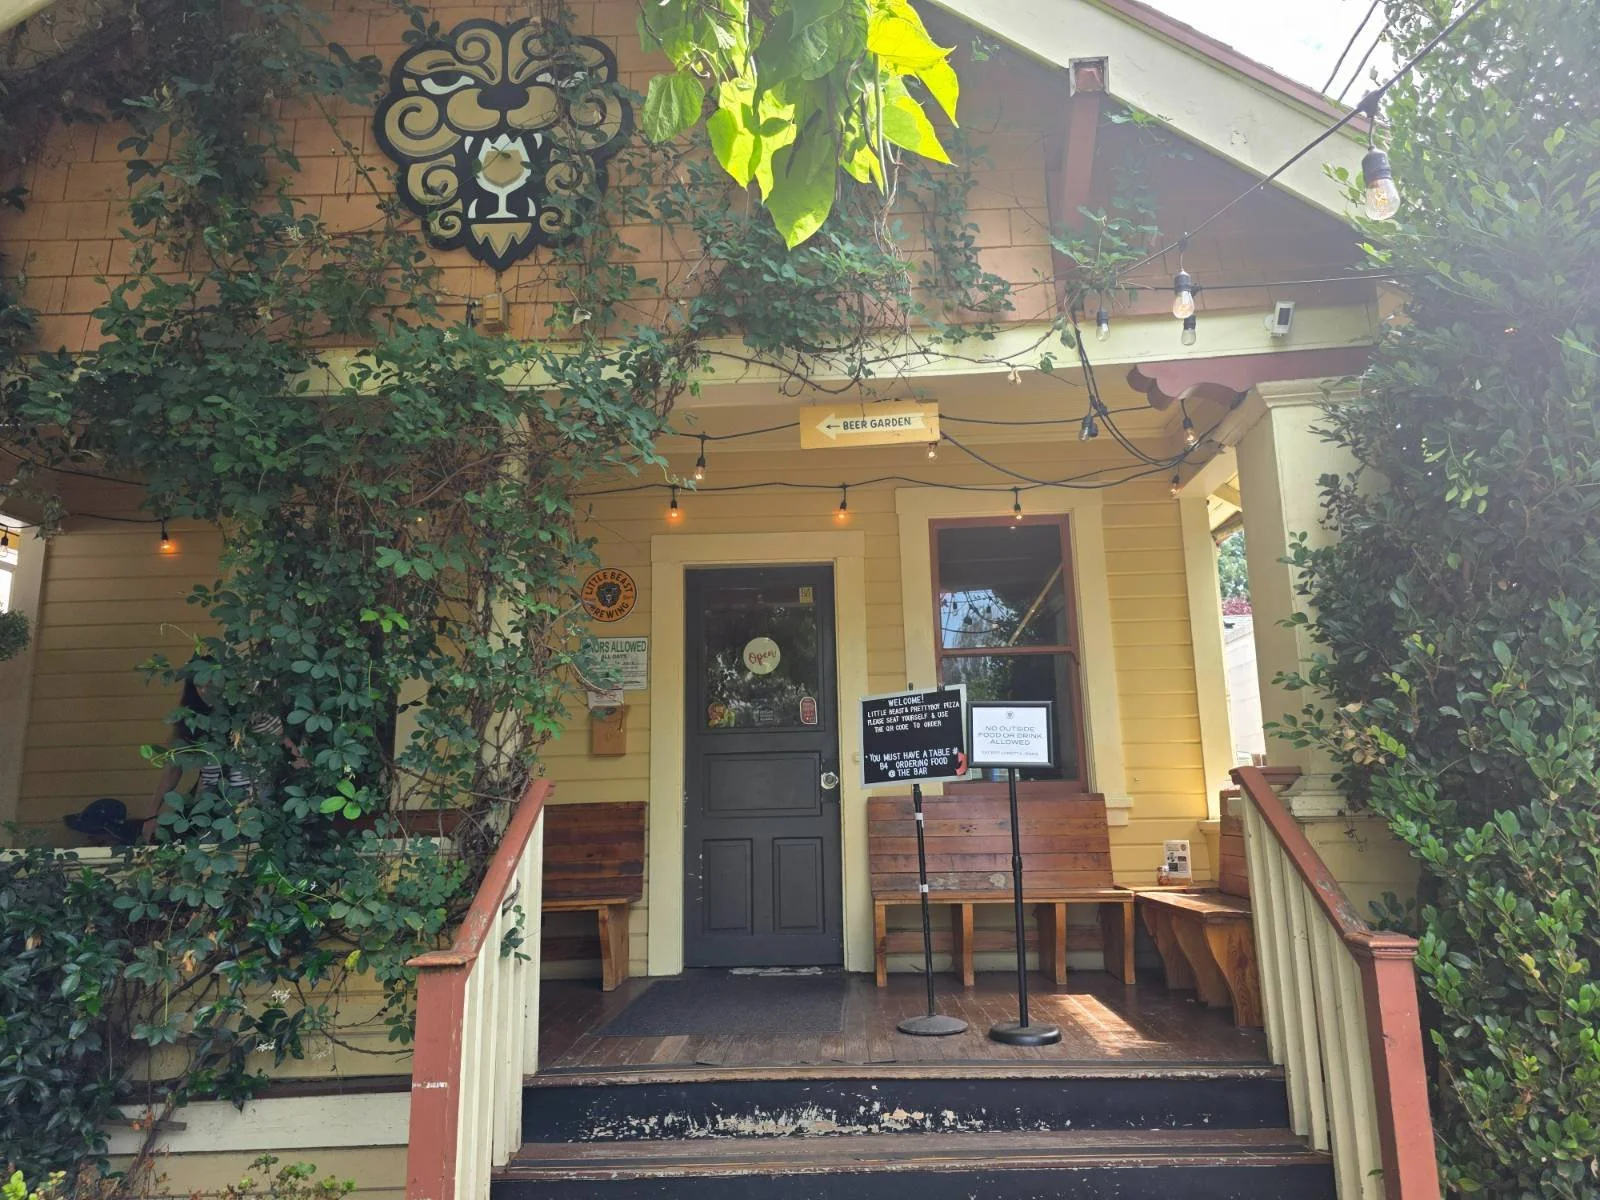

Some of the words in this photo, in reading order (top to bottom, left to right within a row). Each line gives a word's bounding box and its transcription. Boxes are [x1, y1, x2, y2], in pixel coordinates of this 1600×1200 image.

[843, 419, 868, 431] BEER
[870, 416, 912, 429] GARDEN
[584, 571, 609, 595] LITTLE
[610, 571, 634, 592] BEAST
[611, 640, 647, 653] ALLOWED
[748, 649, 777, 666] Open
[888, 693, 925, 706] WELCOME!
[867, 709, 887, 717] LITTLE
[910, 703, 940, 713] PRETTYBOY
[943, 700, 960, 709] PIZZA
[867, 717, 885, 727] PLEASE
[886, 715, 899, 725] SEAT
[901, 712, 928, 722] YOURSELF
[937, 710, 949, 718] USE
[874, 726, 885, 734] THE
[885, 724, 895, 732] QR
[895, 723, 909, 731] CODE
[913, 721, 921, 729] TO
[923, 719, 942, 728] ORDER
[869, 754, 880, 762] YOU
[883, 753, 901, 761] MUST
[903, 751, 920, 759] HAVE
[922, 750, 928, 758] A
[929, 748, 951, 756] TABLE
[879, 762, 889, 770] B4
[895, 760, 929, 769] ORDERING
[930, 757, 948, 766] FOOD
[897, 768, 911, 776] THE
[913, 767, 928, 776] BAR
